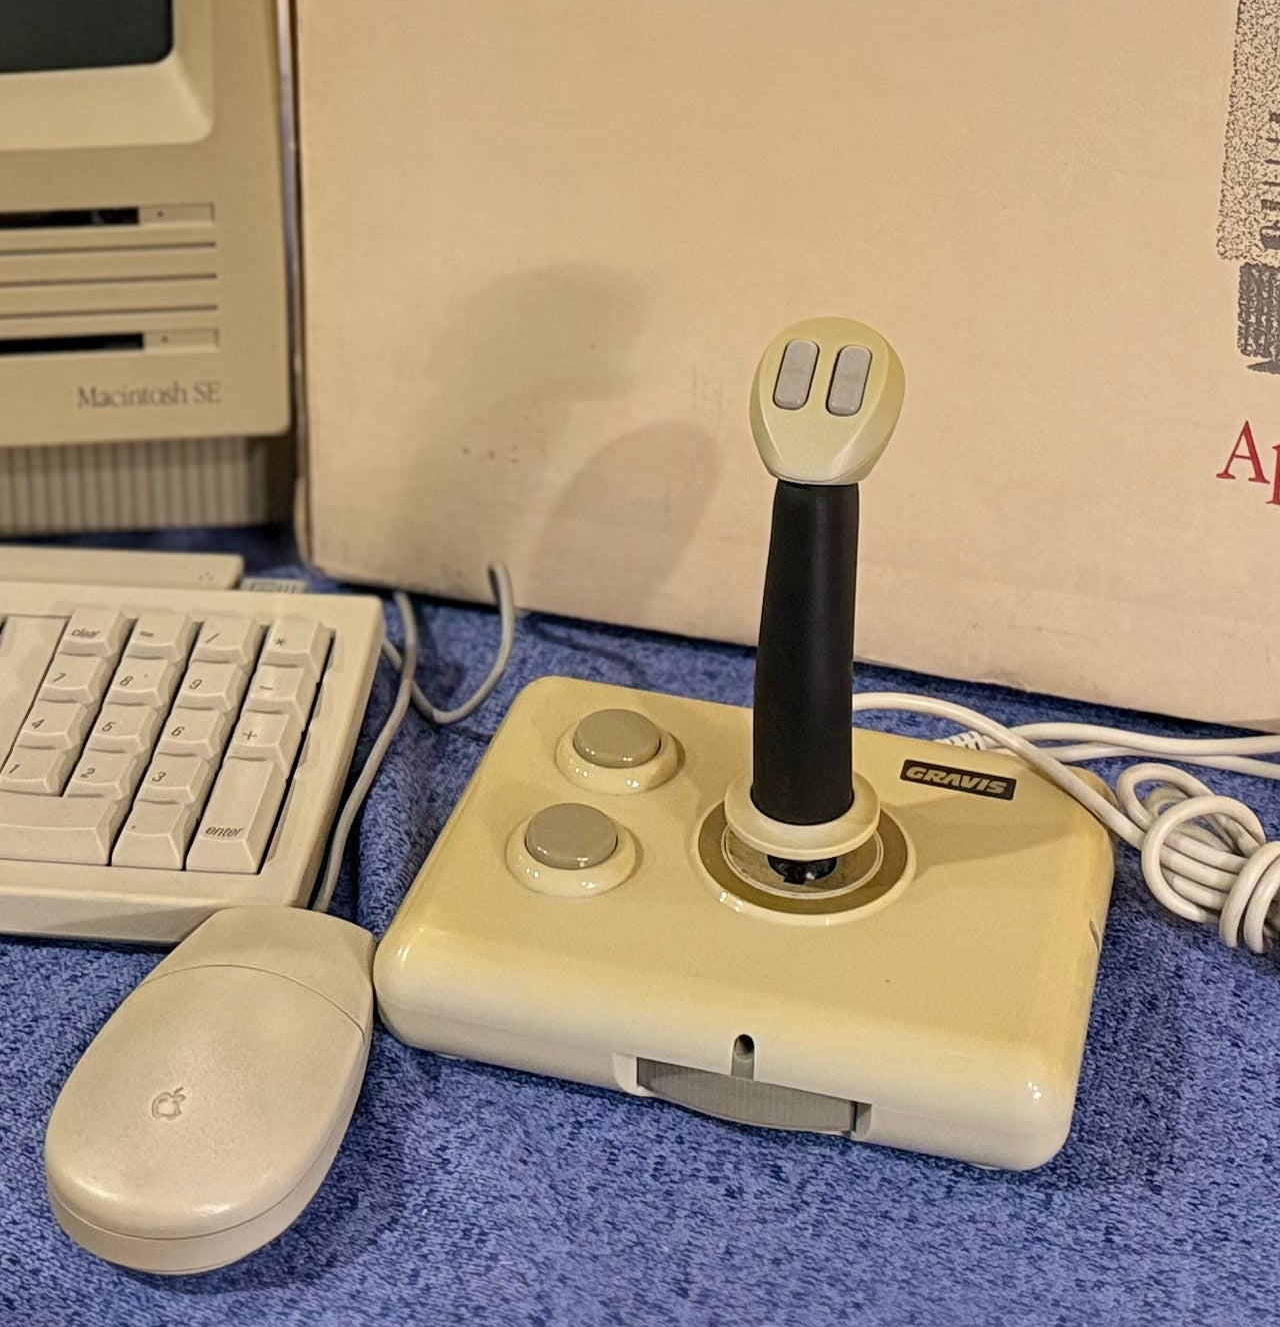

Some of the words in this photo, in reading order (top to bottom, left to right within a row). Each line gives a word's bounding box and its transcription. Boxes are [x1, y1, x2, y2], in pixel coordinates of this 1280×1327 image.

[77, 381, 188, 410] Macintosh
[192, 379, 222, 405] SE
[70, 628, 101, 639] clear
[52, 672, 67, 683] 7
[119, 674, 134, 687] 8
[188, 677, 204, 690] 9
[31, 718, 46, 730] 4
[101, 720, 117, 733] 5
[170, 725, 186, 737] 6
[8, 763, 21, 775] 1
[79, 767, 96, 779] 2
[151, 771, 167, 783] 3
[905, 765, 1009, 794] GRAVIS
[204, 825, 246, 839] enter
